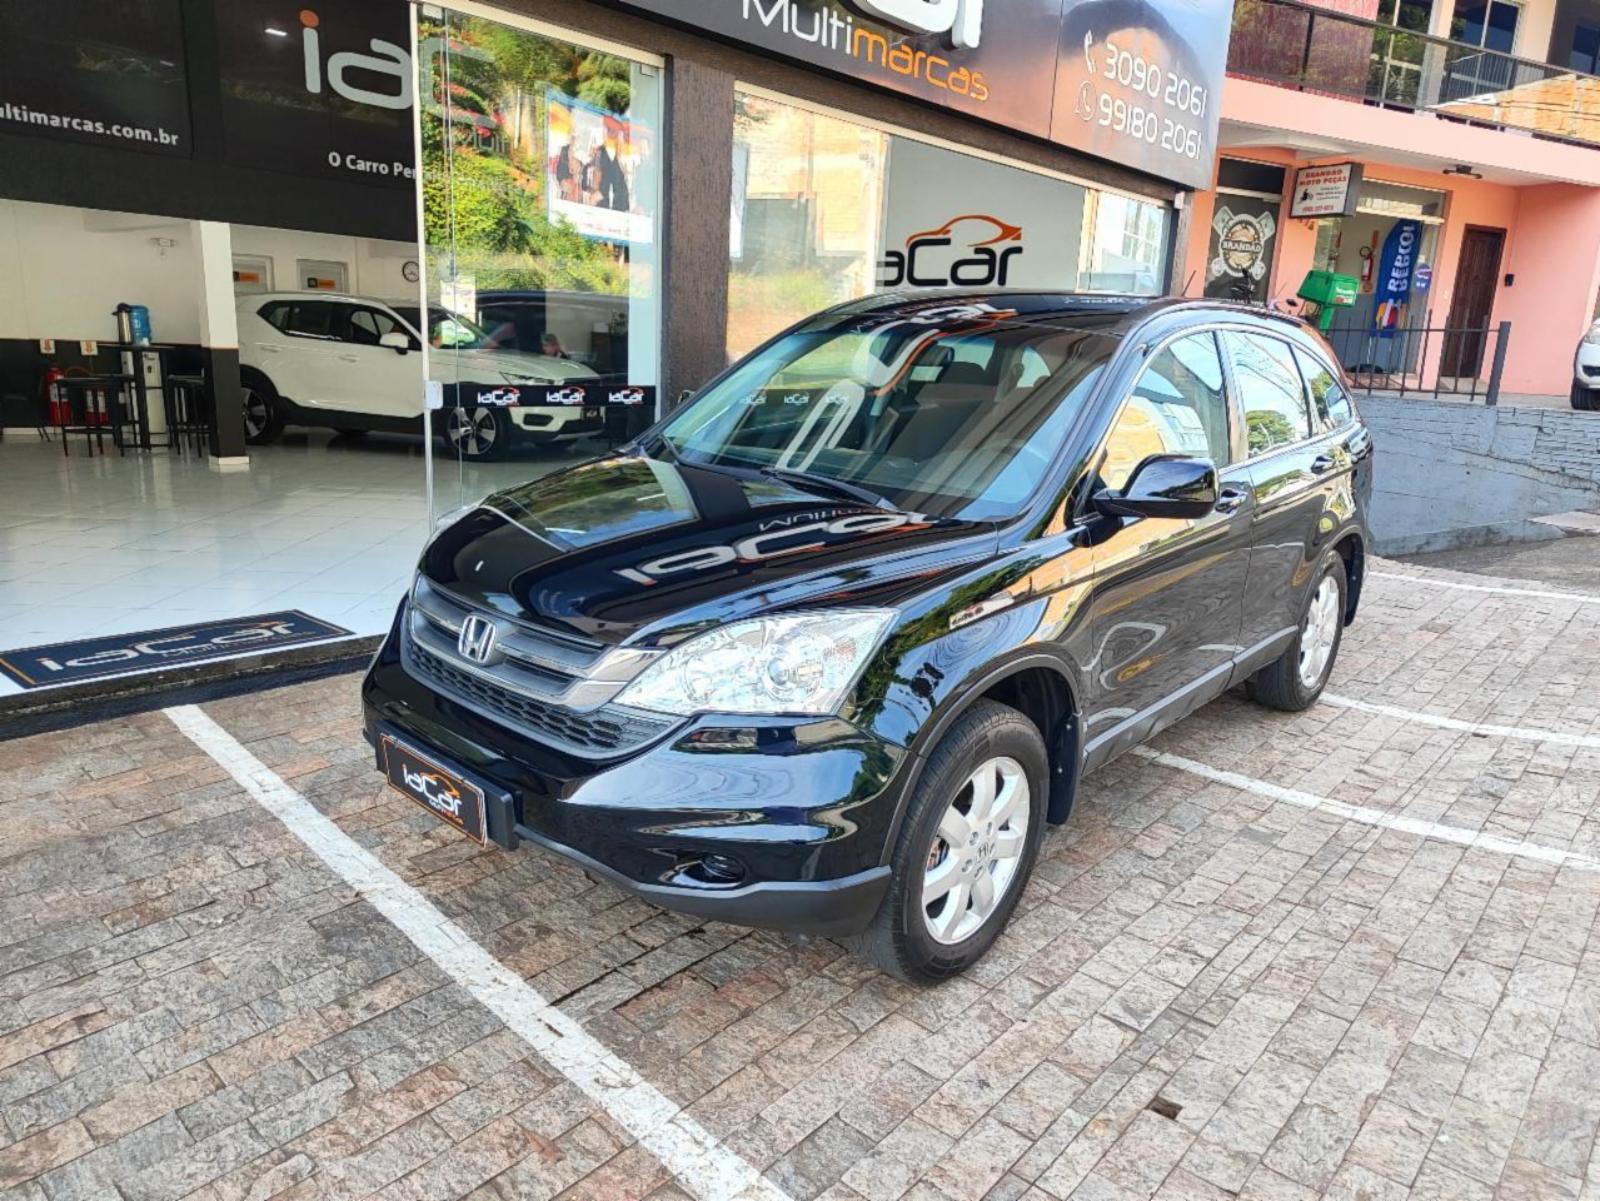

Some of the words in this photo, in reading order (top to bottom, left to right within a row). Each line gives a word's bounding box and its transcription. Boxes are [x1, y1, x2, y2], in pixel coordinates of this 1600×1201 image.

[742, 0, 989, 101] Multimarcas
[1104, 42, 1161, 98] 3090
[1164, 73, 1207, 118] 2061
[1098, 93, 1158, 143] 99180
[1161, 118, 1202, 160] 2061
[328, 151, 341, 168] O
[345, 154, 389, 175] Carro
